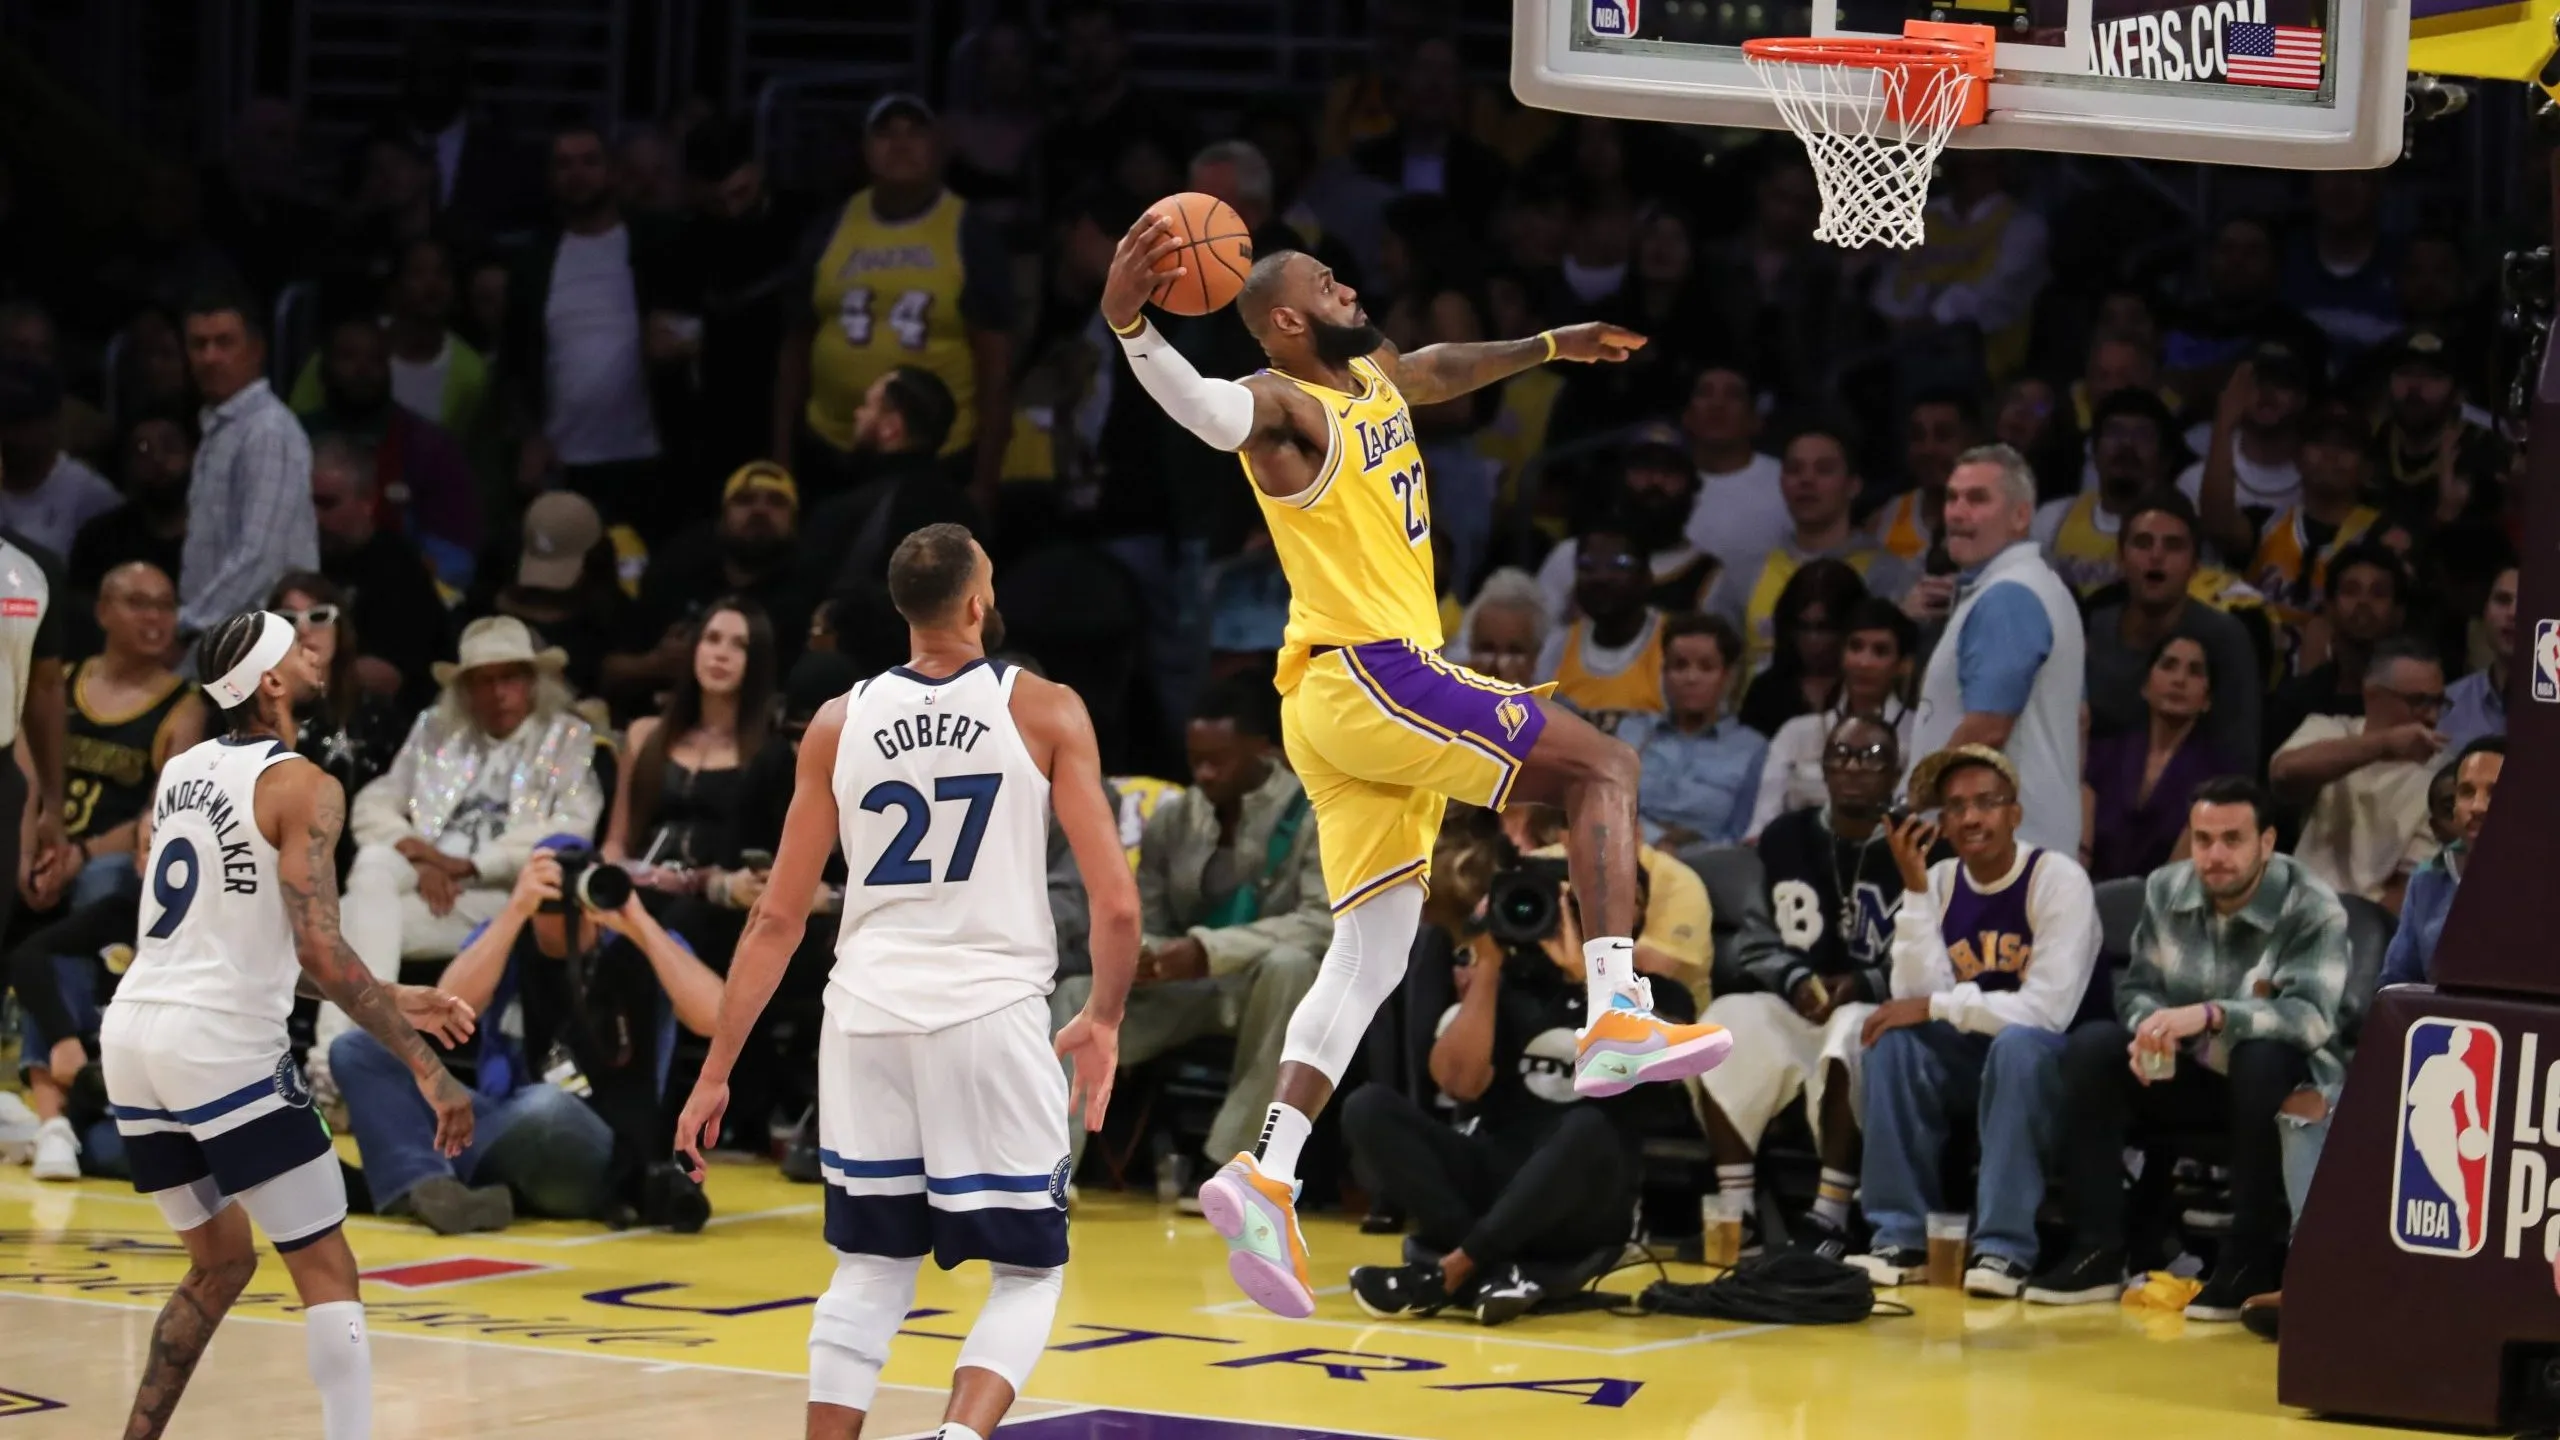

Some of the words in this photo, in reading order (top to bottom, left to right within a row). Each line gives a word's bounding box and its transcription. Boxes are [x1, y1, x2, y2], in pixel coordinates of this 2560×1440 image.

[1596, 7, 1620, 29] NBA
[873, 713, 990, 760] GOBERT
[152, 779, 257, 895] ANDER-WALKER
[859, 772, 1003, 886] 27
[145, 837, 199, 939] 9
[2405, 1199, 2450, 1240] NBA
